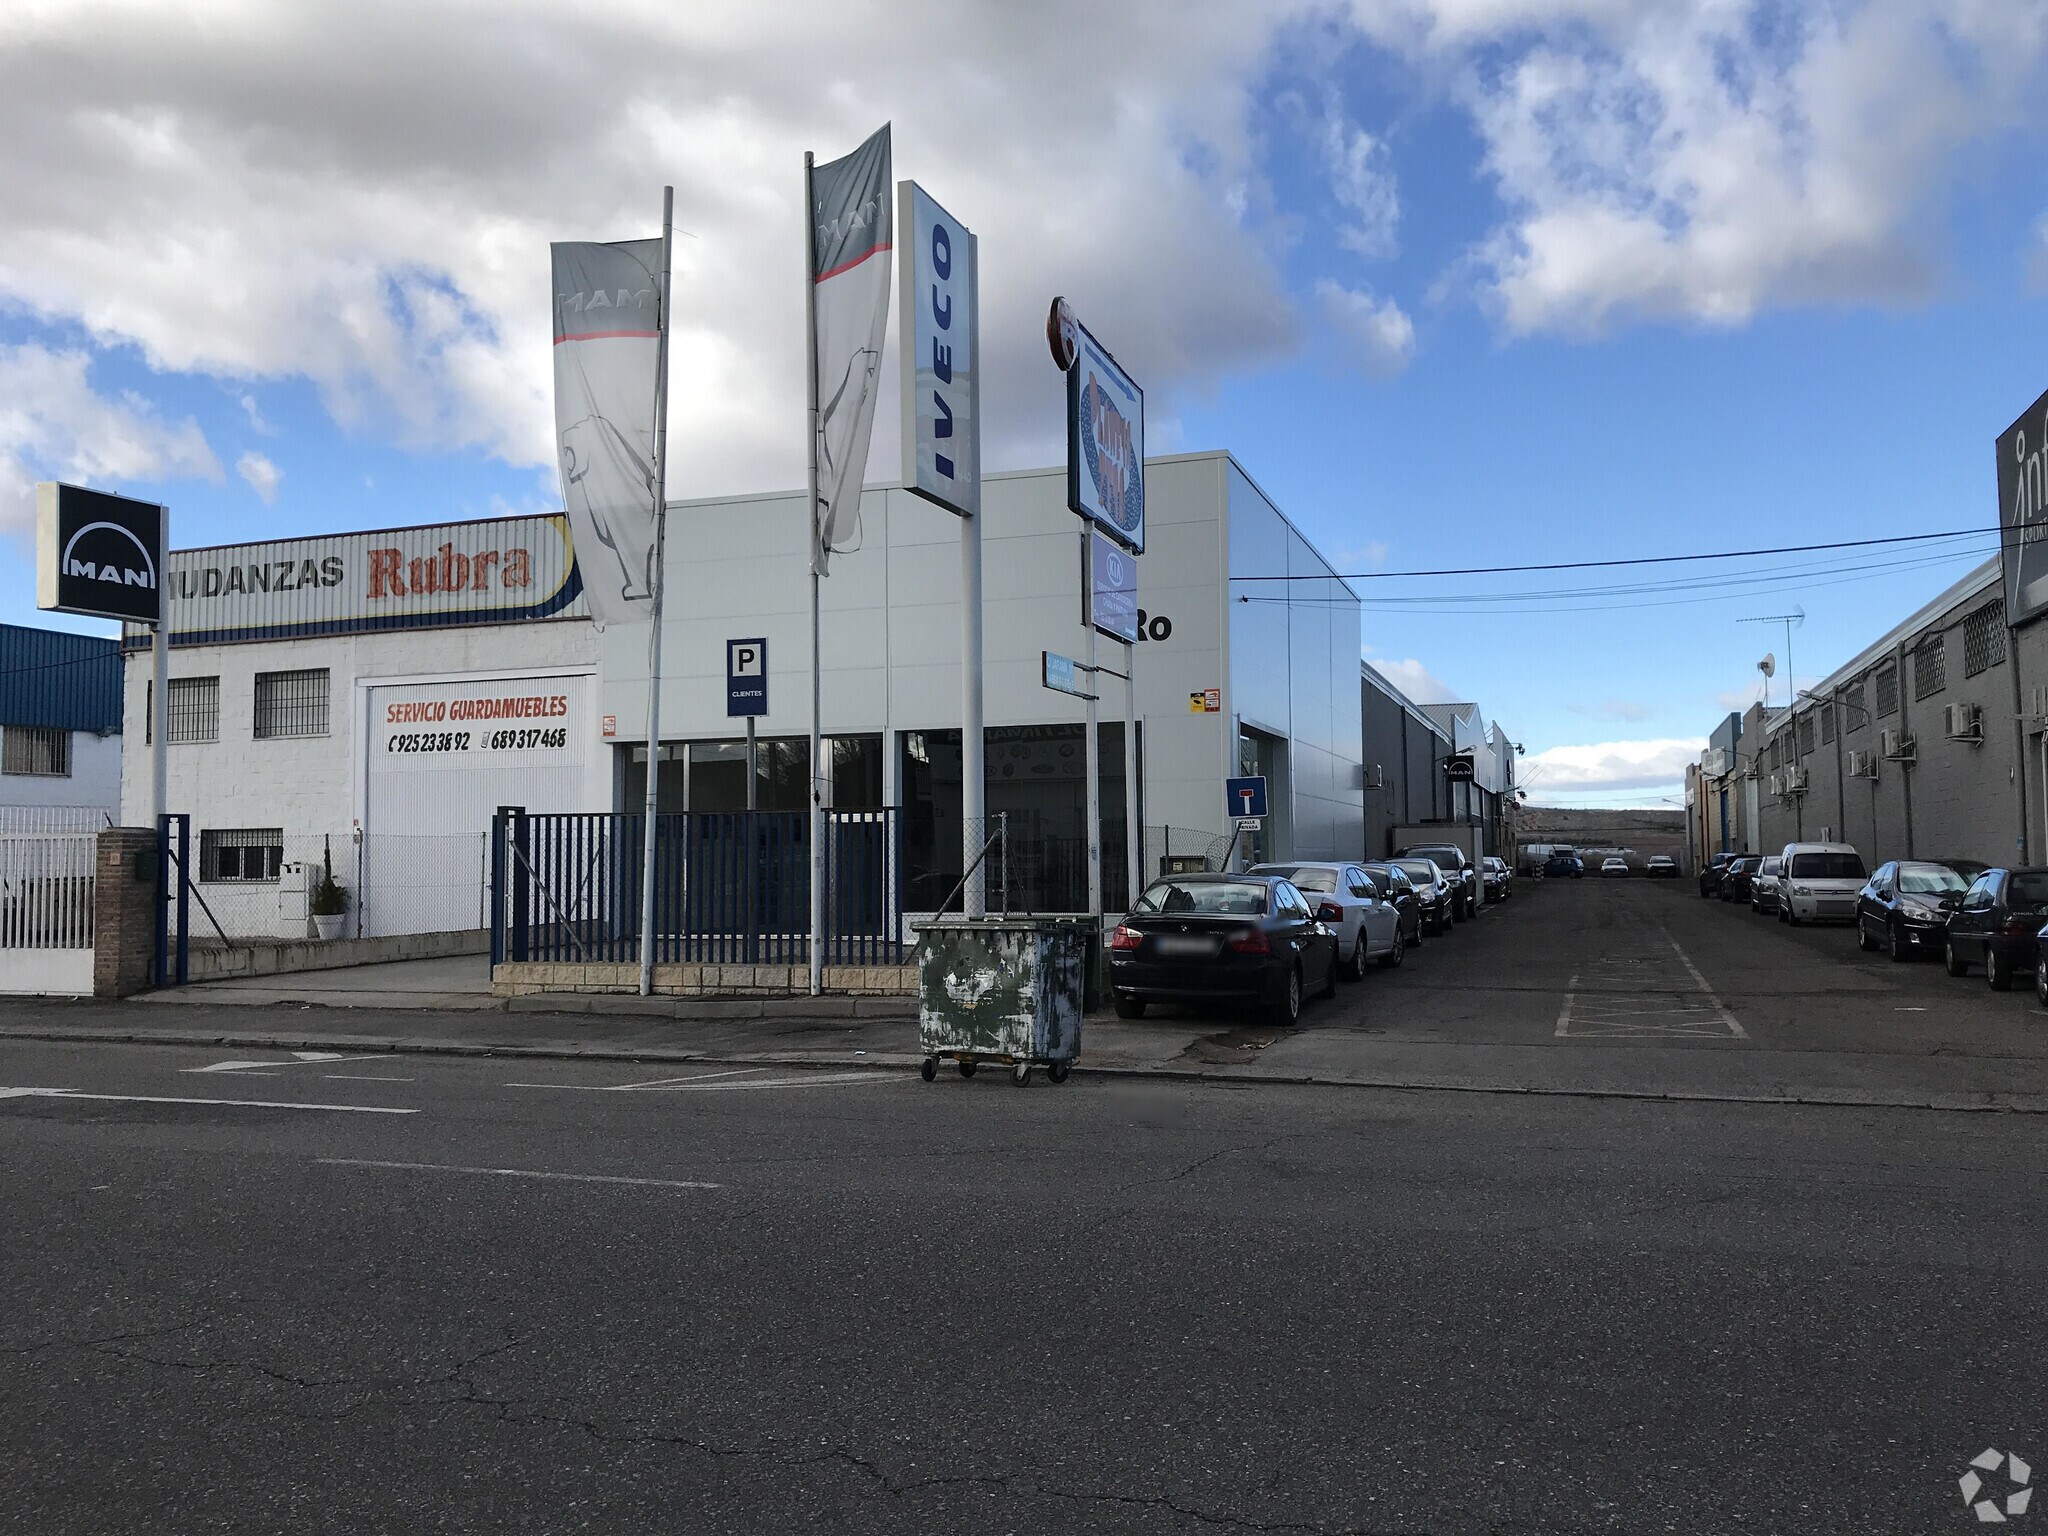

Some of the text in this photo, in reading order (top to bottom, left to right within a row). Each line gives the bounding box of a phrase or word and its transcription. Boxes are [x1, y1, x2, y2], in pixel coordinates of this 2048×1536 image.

[932, 223, 955, 481] IVECO
[70, 558, 148, 589] MAN
[366, 542, 532, 600] Rubra
[1109, 558, 1121, 581] KIA
[739, 649, 755, 672] P
[386, 695, 568, 724] SERVICIO GUARDAMUEBLES
